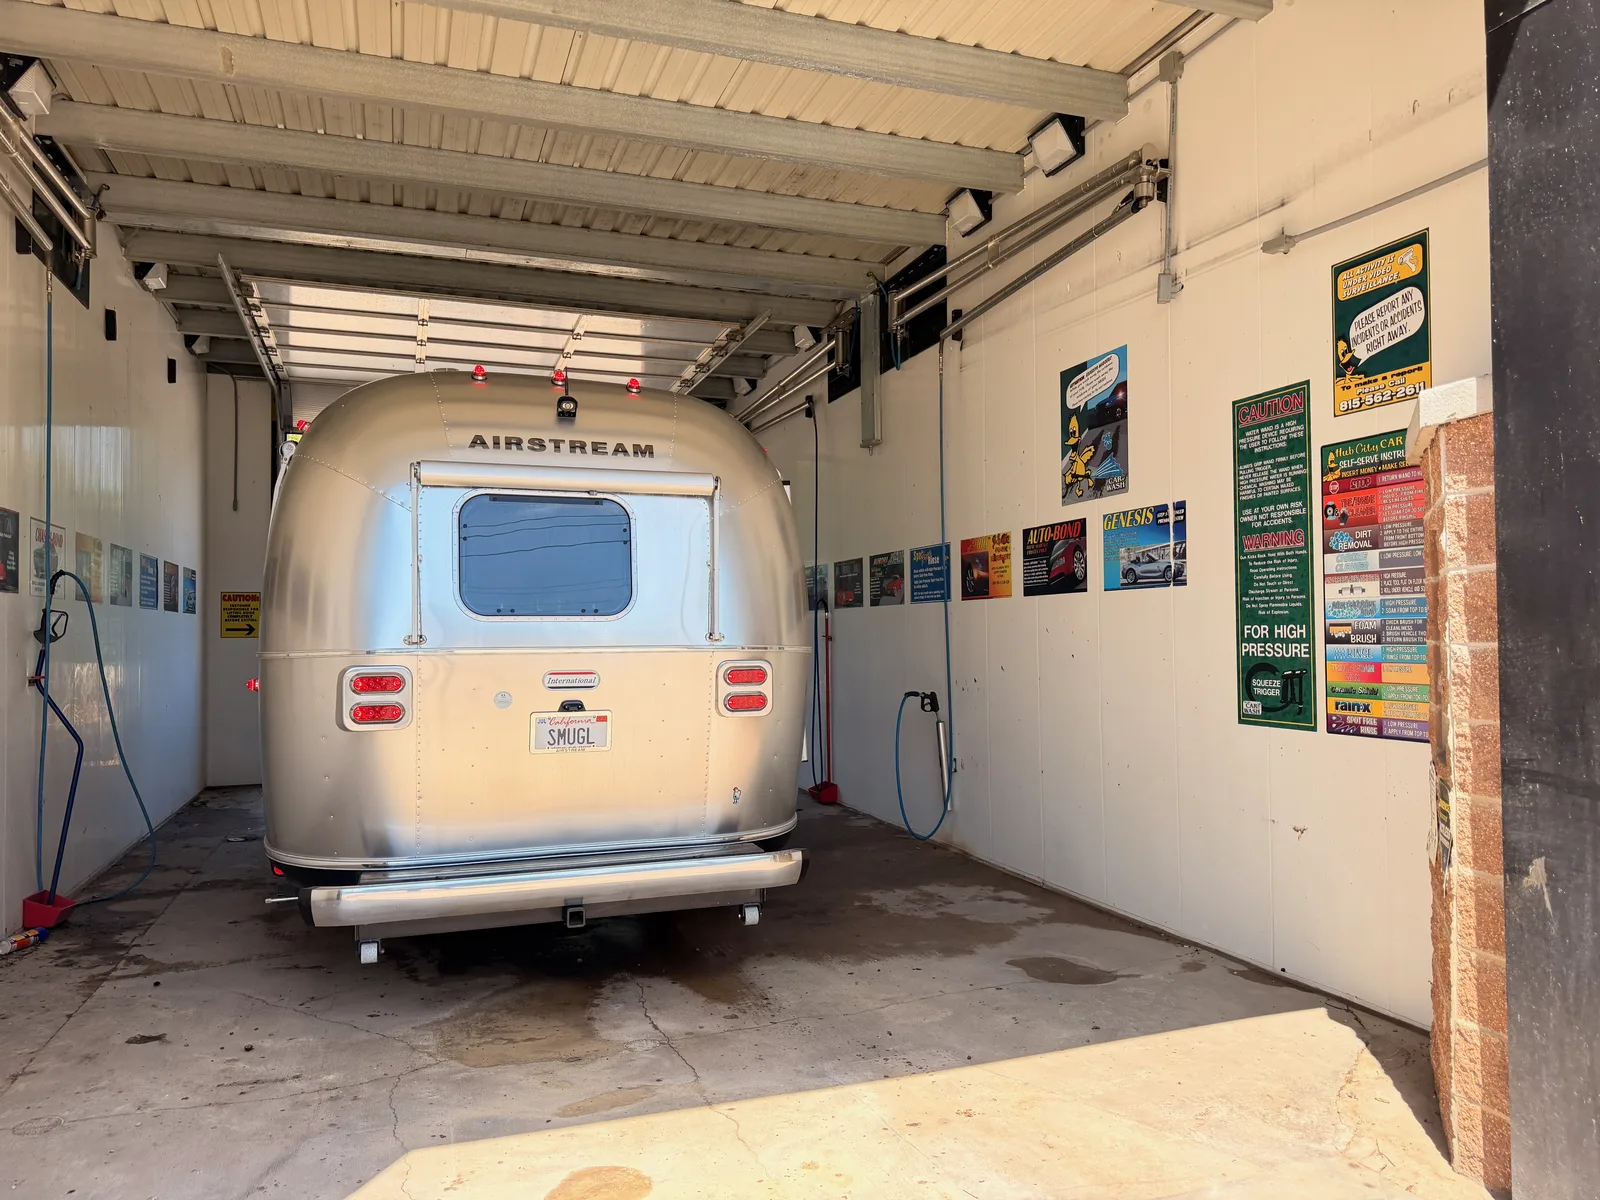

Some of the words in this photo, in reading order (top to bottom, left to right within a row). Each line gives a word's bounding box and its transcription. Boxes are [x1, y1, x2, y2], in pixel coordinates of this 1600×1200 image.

[1343, 272, 1354, 280] ALL
[1356, 260, 1385, 275] ACTIVITY
[1388, 255, 1395, 263] IS
[1343, 276, 1367, 289] UNDER
[1370, 266, 1392, 278] VIDEO
[1343, 272, 1400, 298] SURVEILLANCE.
[1354, 311, 1375, 331] PLEASE
[1376, 297, 1399, 319] REPORT
[1402, 289, 1414, 304] ANY
[1351, 324, 1380, 348] INCIDENTS
[1381, 319, 1389, 331] OR
[1390, 300, 1422, 326] ACCIDENTS
[1366, 335, 1387, 354] RIGHT
[1388, 322, 1410, 343] AWAY.
[1355, 379, 1378, 387] make
[1357, 384, 1386, 395] Please
[1389, 378, 1406, 387] Call
[1340, 382, 1425, 411] 815-562-2611
[1239, 391, 1303, 423] CAUTION
[1249, 440, 1260, 448] USER
[1269, 435, 1287, 444] FOLLOW
[1289, 431, 1304, 439] THESE
[1262, 431, 1278, 439] DEVICE
[468, 434, 655, 458] AIRSTREAM
[1335, 447, 1354, 458] Hub
[1356, 443, 1378, 454] City
[1380, 436, 1404, 448] CAR
[1339, 454, 1379, 469] SELF-SERVE
[1342, 469, 1359, 478] INSERT
[1360, 466, 1378, 475] MONEY
[1106, 482, 1124, 490] WASH
[1109, 476, 1121, 484] CAR
[1350, 477, 1371, 489] STOP
[1104, 507, 1154, 530] GENESIS
[1271, 508, 1306, 518] RESPONSIBLE
[1027, 522, 1081, 544] AUTO-BOND
[1242, 529, 1304, 550] WARNING
[1355, 530, 1372, 538] DIRT
[1339, 540, 1372, 549] REMOVAL
[1244, 625, 1269, 638] FOR
[1275, 624, 1306, 638] HIGH
[1354, 621, 1376, 630] FOAM
[1351, 634, 1377, 643] BRUSH
[1242, 643, 1309, 657] PRESSURE
[1346, 648, 1373, 658] RINSE
[1252, 679, 1281, 687] SQUEEZE
[1253, 688, 1280, 696] TRIGGER
[549, 716, 594, 727] California
[1347, 716, 1361, 724] SPOT
[547, 728, 595, 746] SMUGL
[1360, 726, 1377, 734] RINSE
